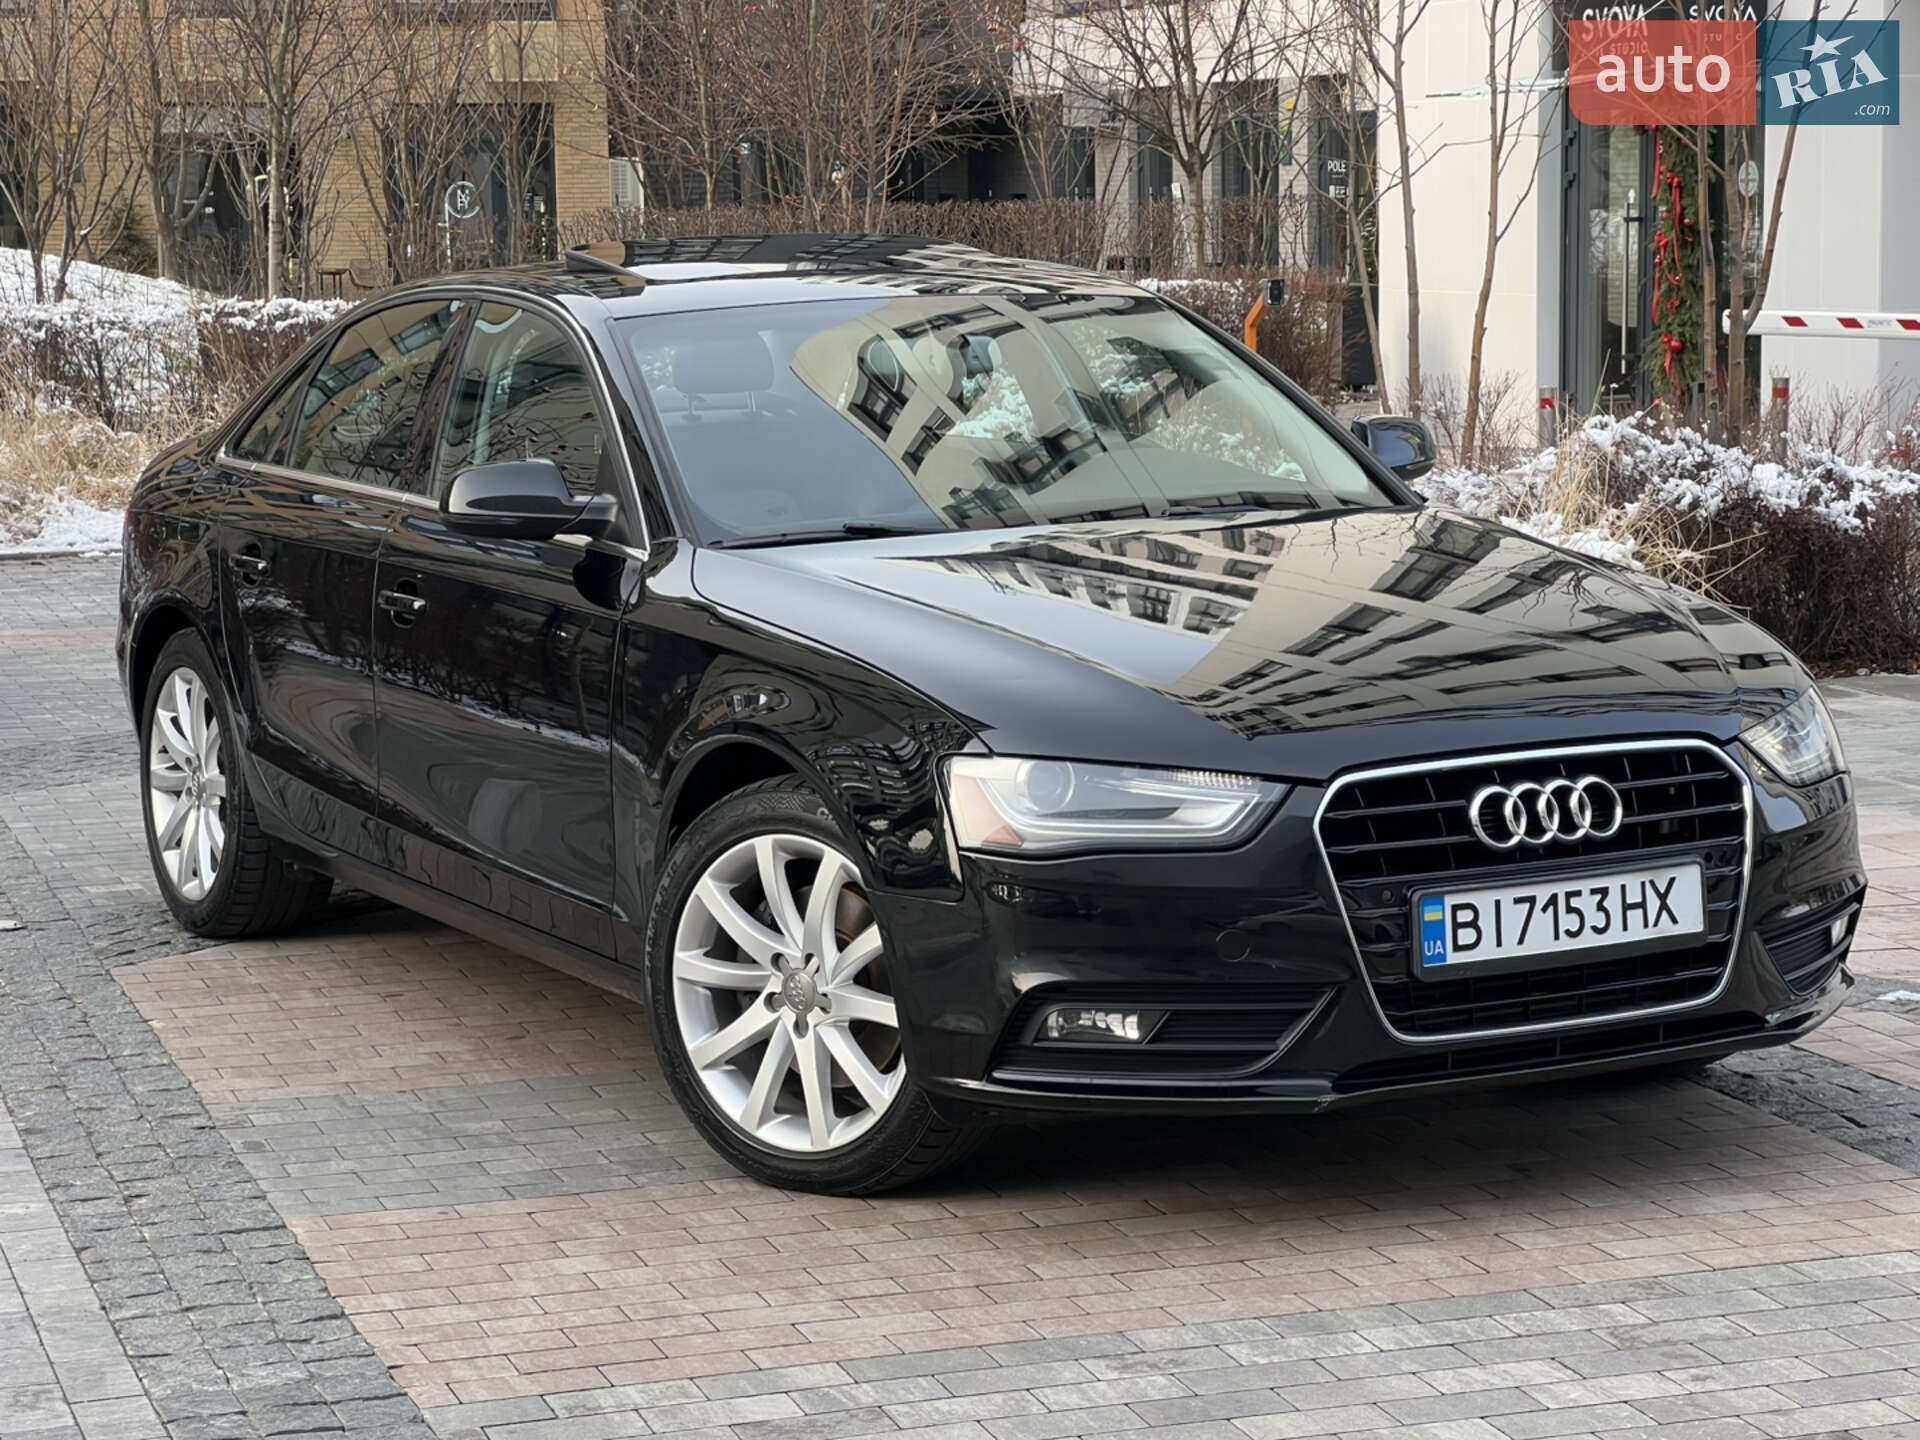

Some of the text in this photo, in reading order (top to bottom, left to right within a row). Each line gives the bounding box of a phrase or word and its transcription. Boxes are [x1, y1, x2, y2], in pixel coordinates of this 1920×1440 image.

[1581, 4, 1648, 41] SVOYA
[1327, 160, 1347, 172] POLE
[1424, 940, 1445, 956] UA
